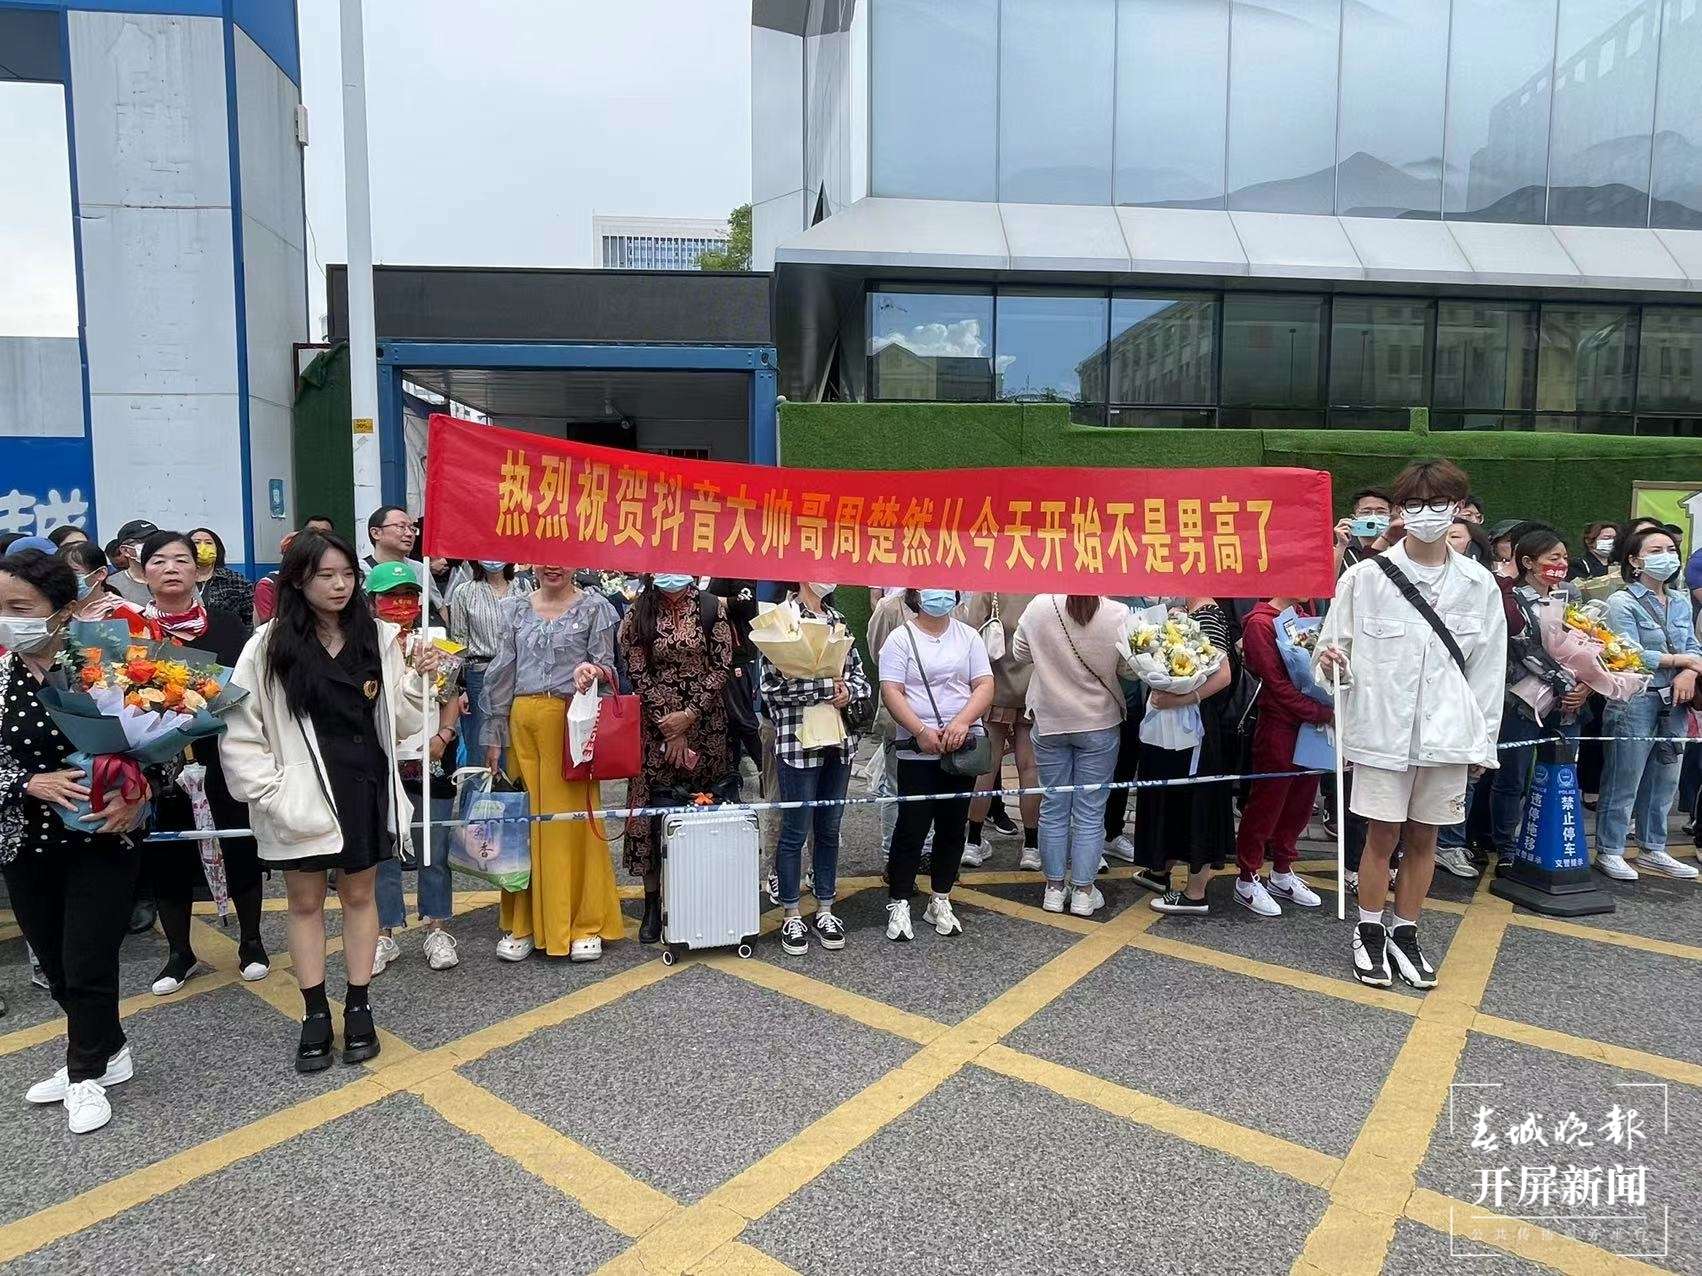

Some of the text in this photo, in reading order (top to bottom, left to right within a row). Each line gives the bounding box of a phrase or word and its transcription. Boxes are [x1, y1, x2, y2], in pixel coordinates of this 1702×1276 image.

[495, 449, 1274, 574] 热烈祝贺抖音大帅哥周楚然从今天开始不是男高了
[1561, 796, 1576, 857] 禁止停车
